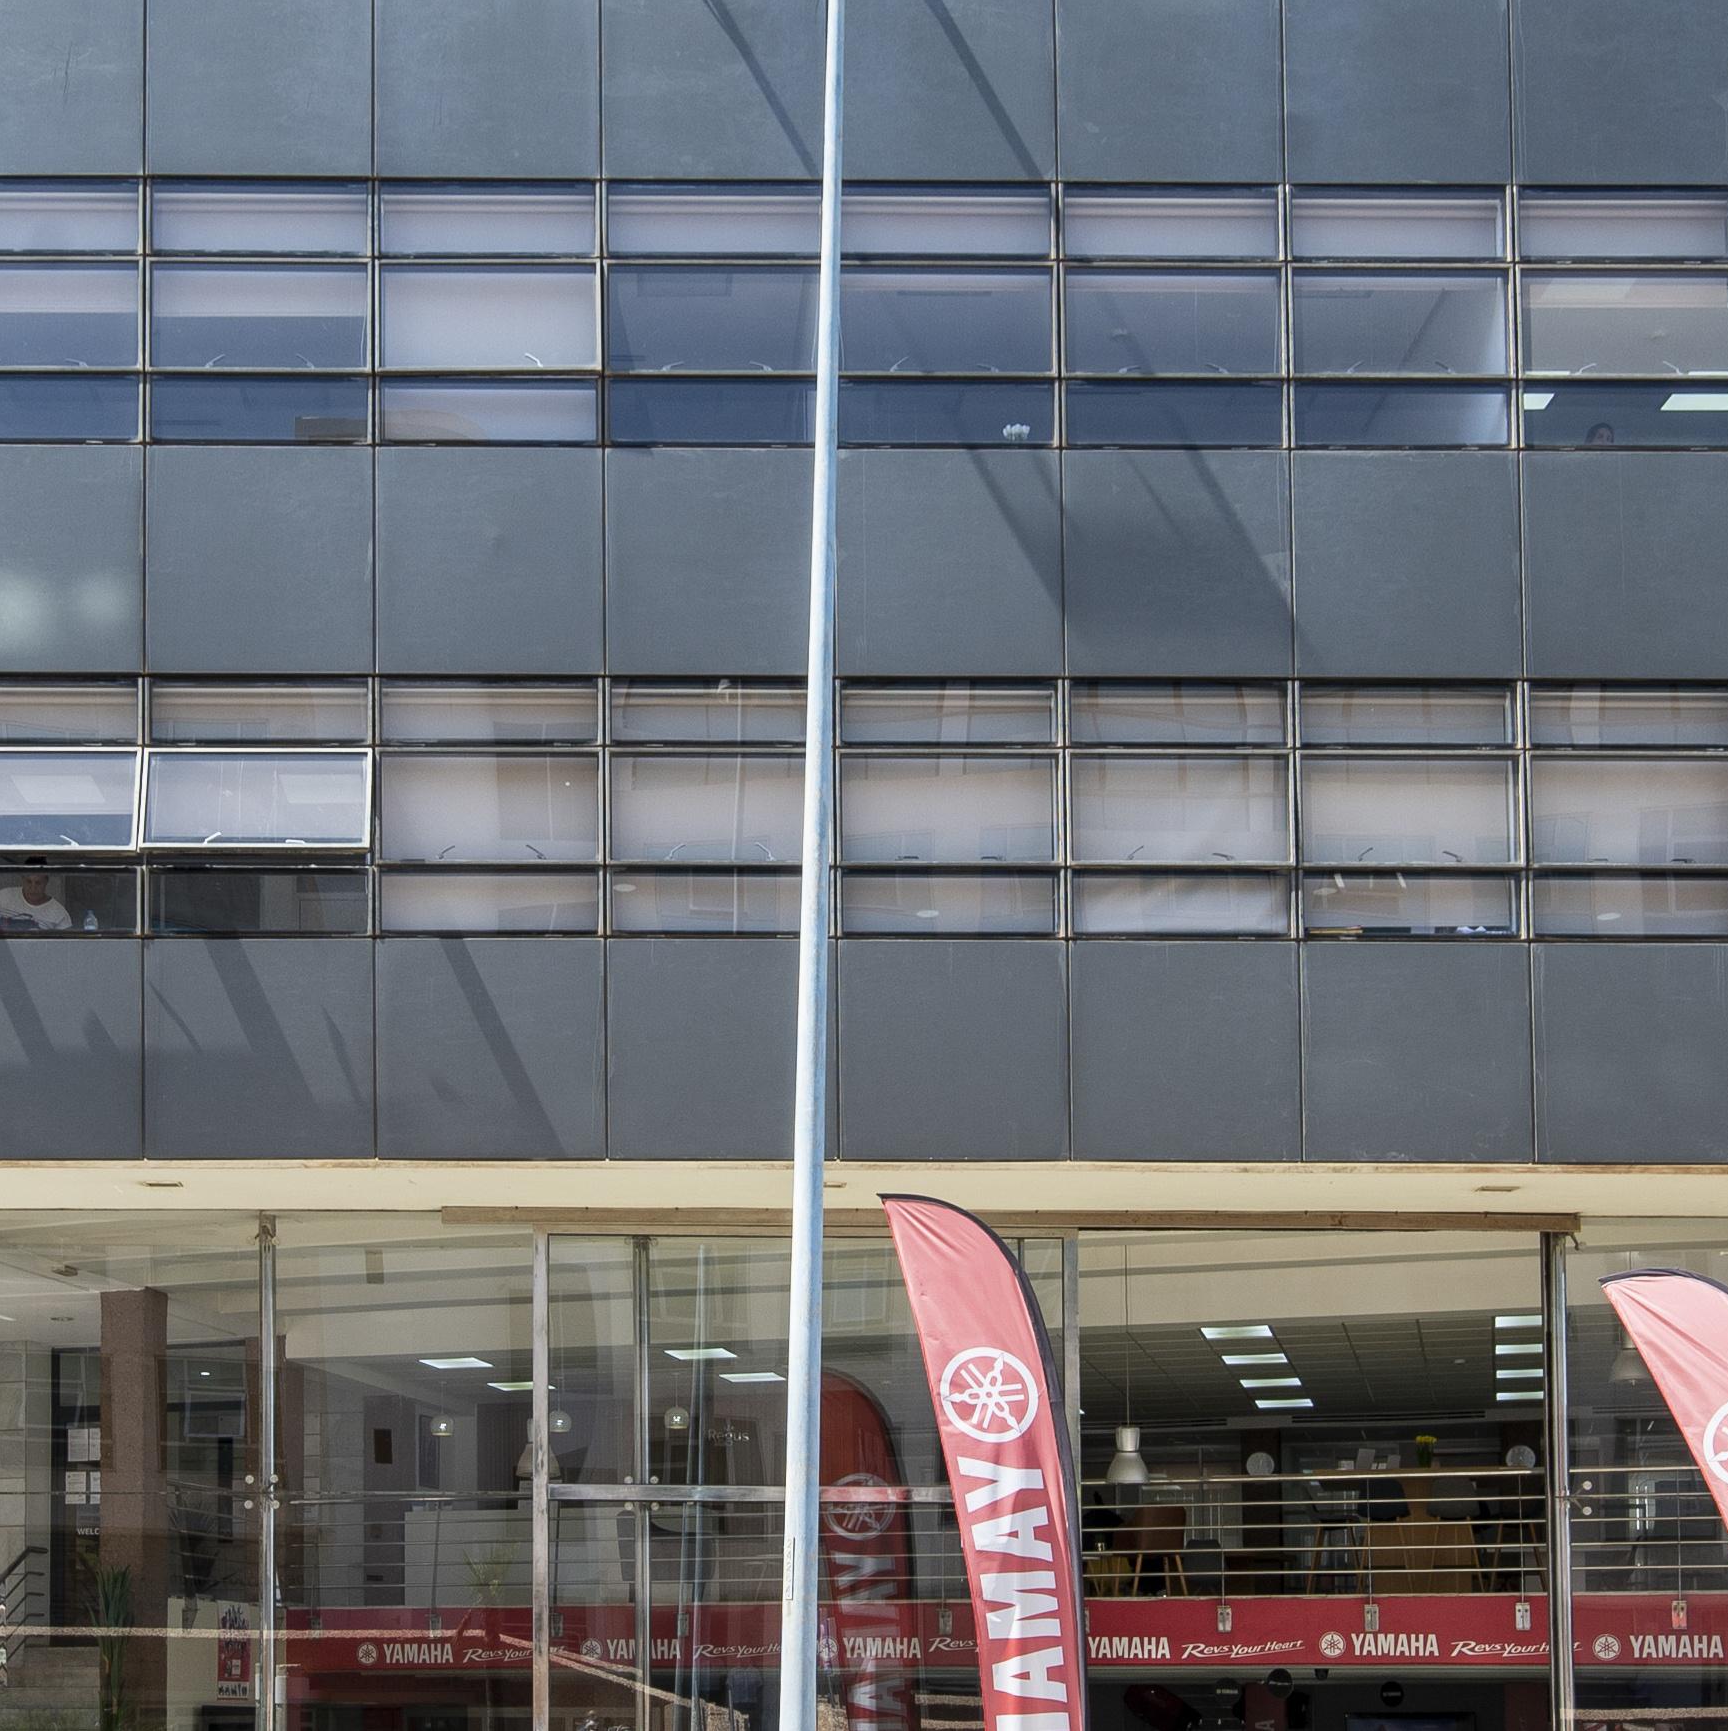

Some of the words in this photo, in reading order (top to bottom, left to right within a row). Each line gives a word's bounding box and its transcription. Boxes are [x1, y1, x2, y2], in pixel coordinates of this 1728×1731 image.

[77, 1527, 100, 1535] WELC
[383, 1643, 453, 1663] YAMAHA
[843, 1637, 921, 1659] YAMAHA
[1088, 1637, 1171, 1659] YAMAHA
[1351, 1633, 1439, 1656] YAMAHA
[1629, 1635, 1724, 1658] YAMAHA
